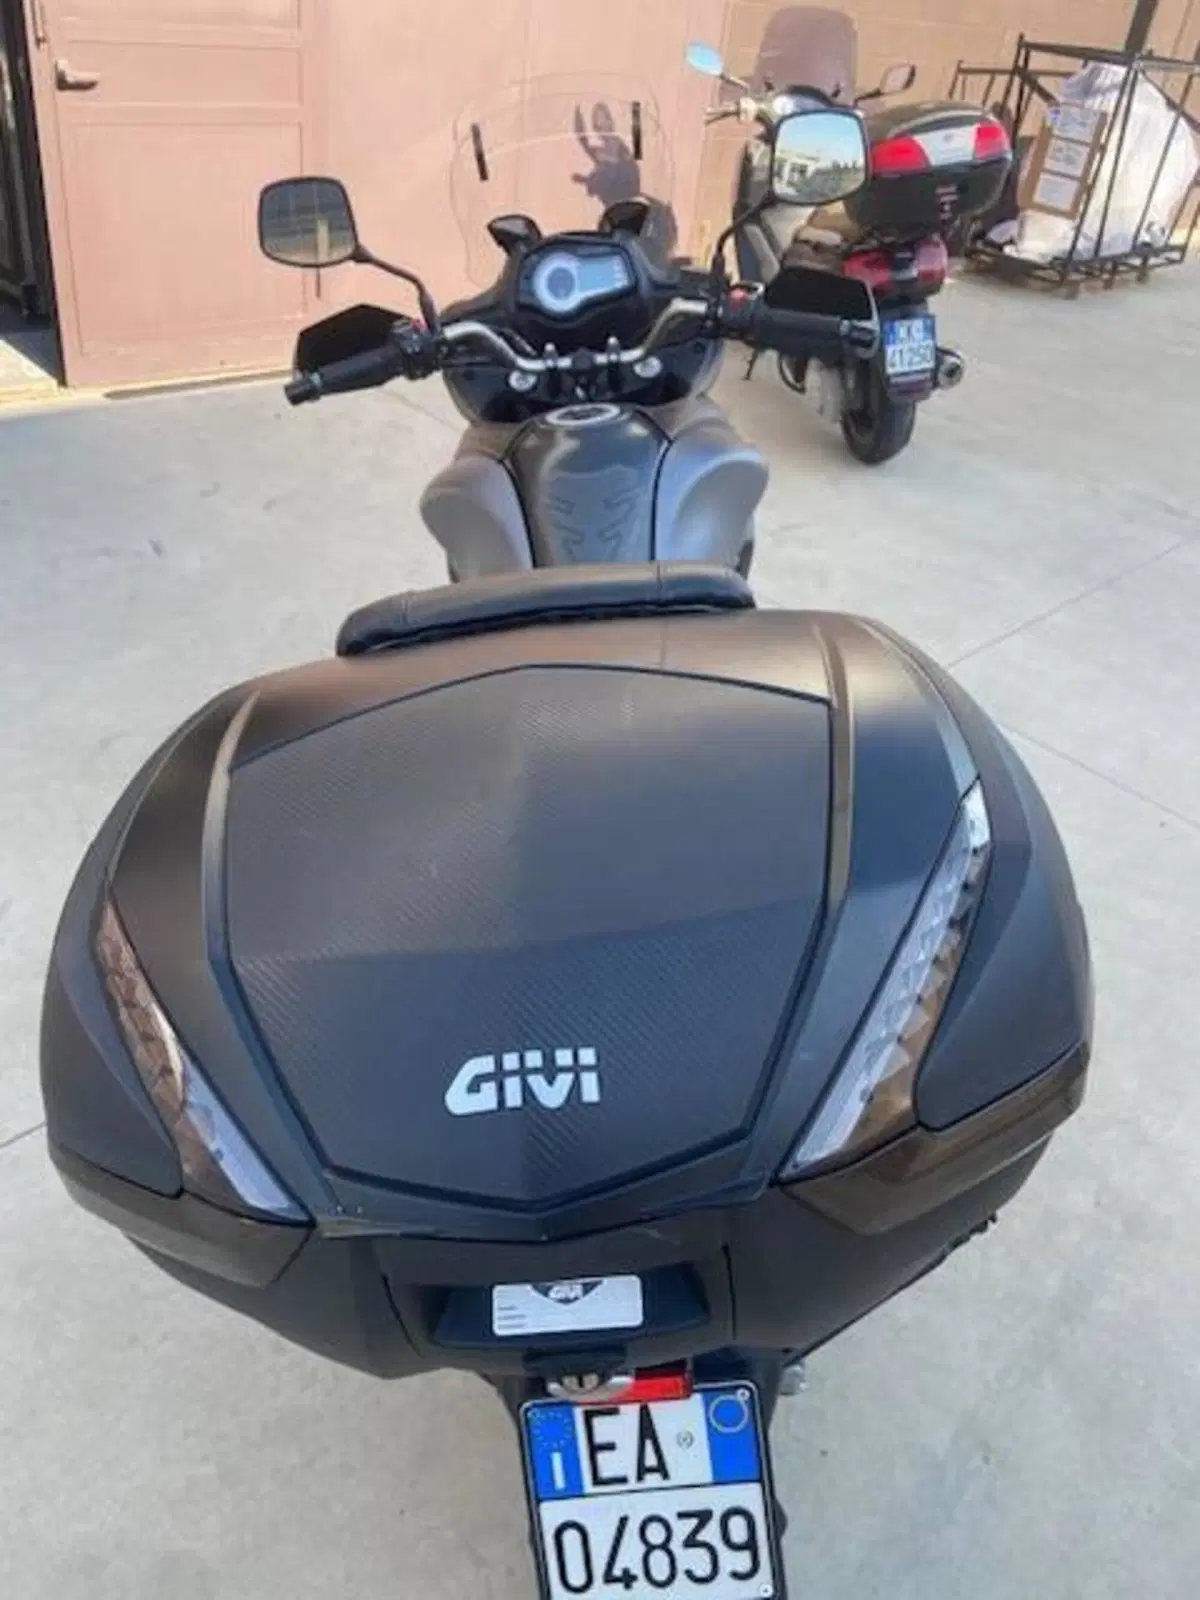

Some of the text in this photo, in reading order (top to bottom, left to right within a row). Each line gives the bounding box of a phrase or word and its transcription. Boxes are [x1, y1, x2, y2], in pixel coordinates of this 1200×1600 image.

[552, 1452, 565, 1490] I
[582, 1403, 670, 1486] EA
[553, 1506, 761, 1594] 04839
